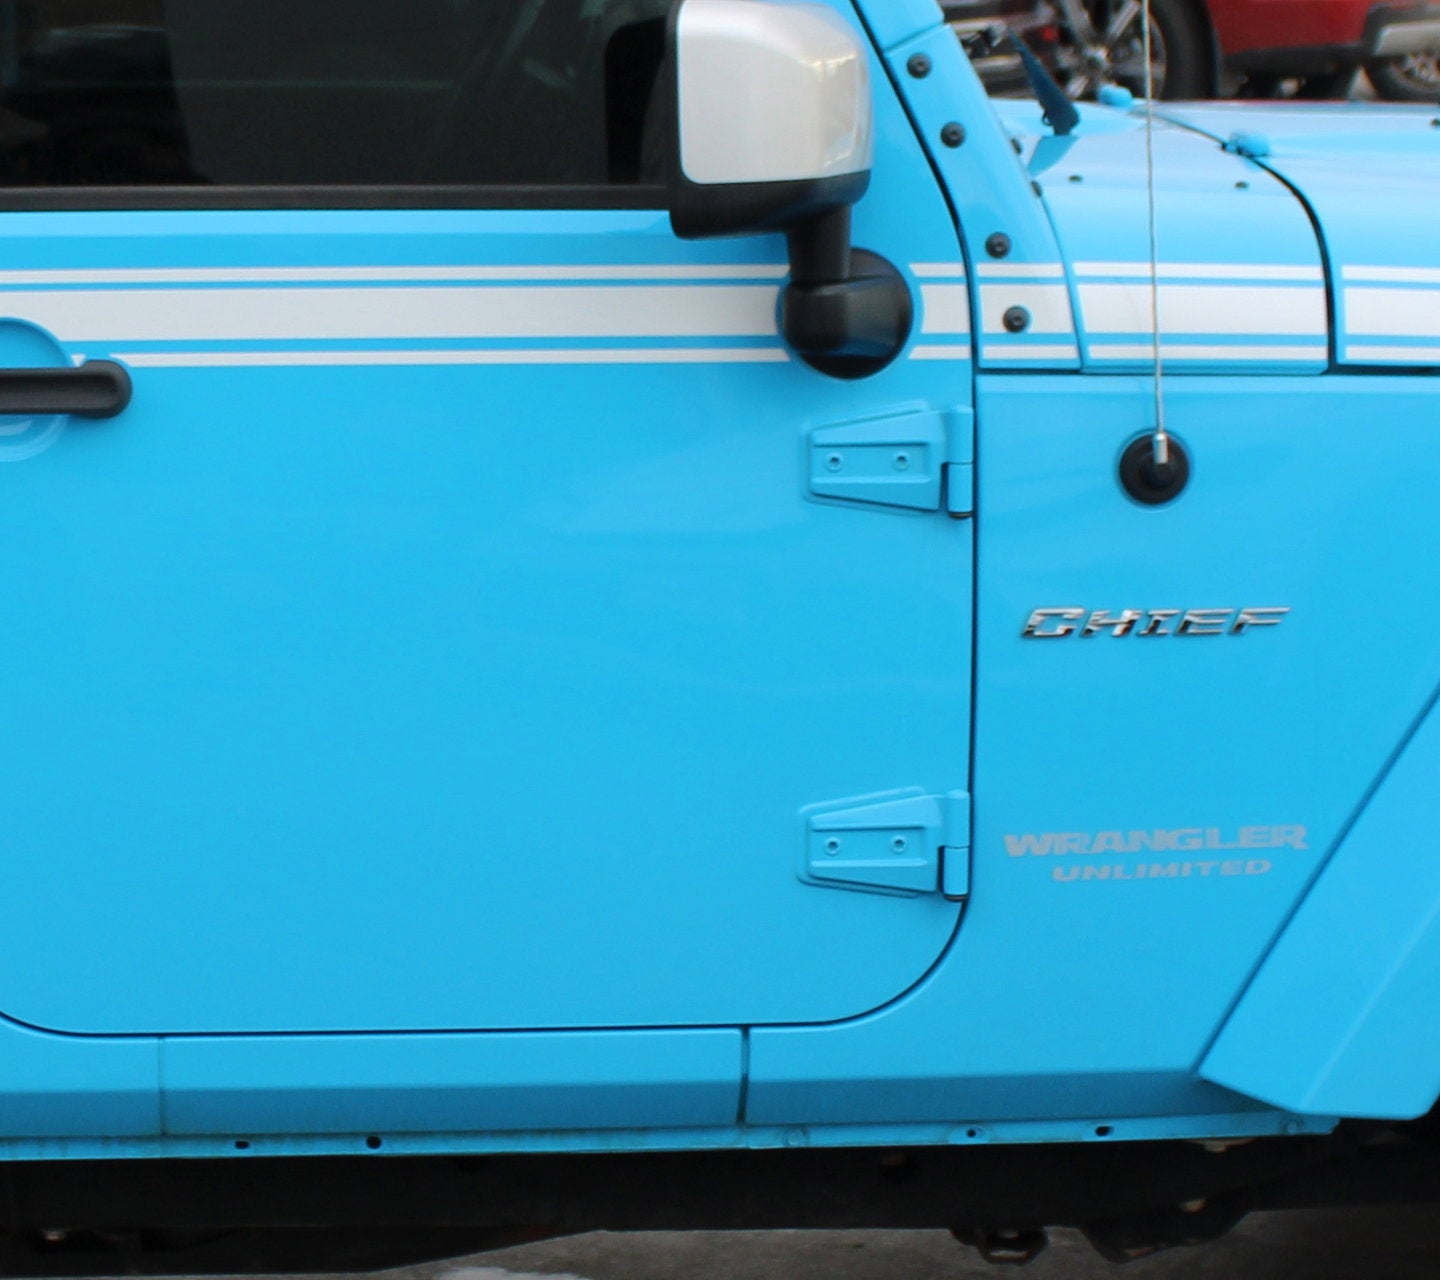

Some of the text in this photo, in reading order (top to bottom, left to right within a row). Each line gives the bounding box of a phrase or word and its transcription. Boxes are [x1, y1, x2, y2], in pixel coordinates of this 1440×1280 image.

[1021, 606, 1291, 639] CHIEF
[1003, 824, 1309, 858] WRANGLER
[1052, 859, 1271, 883] UNLIMITED
